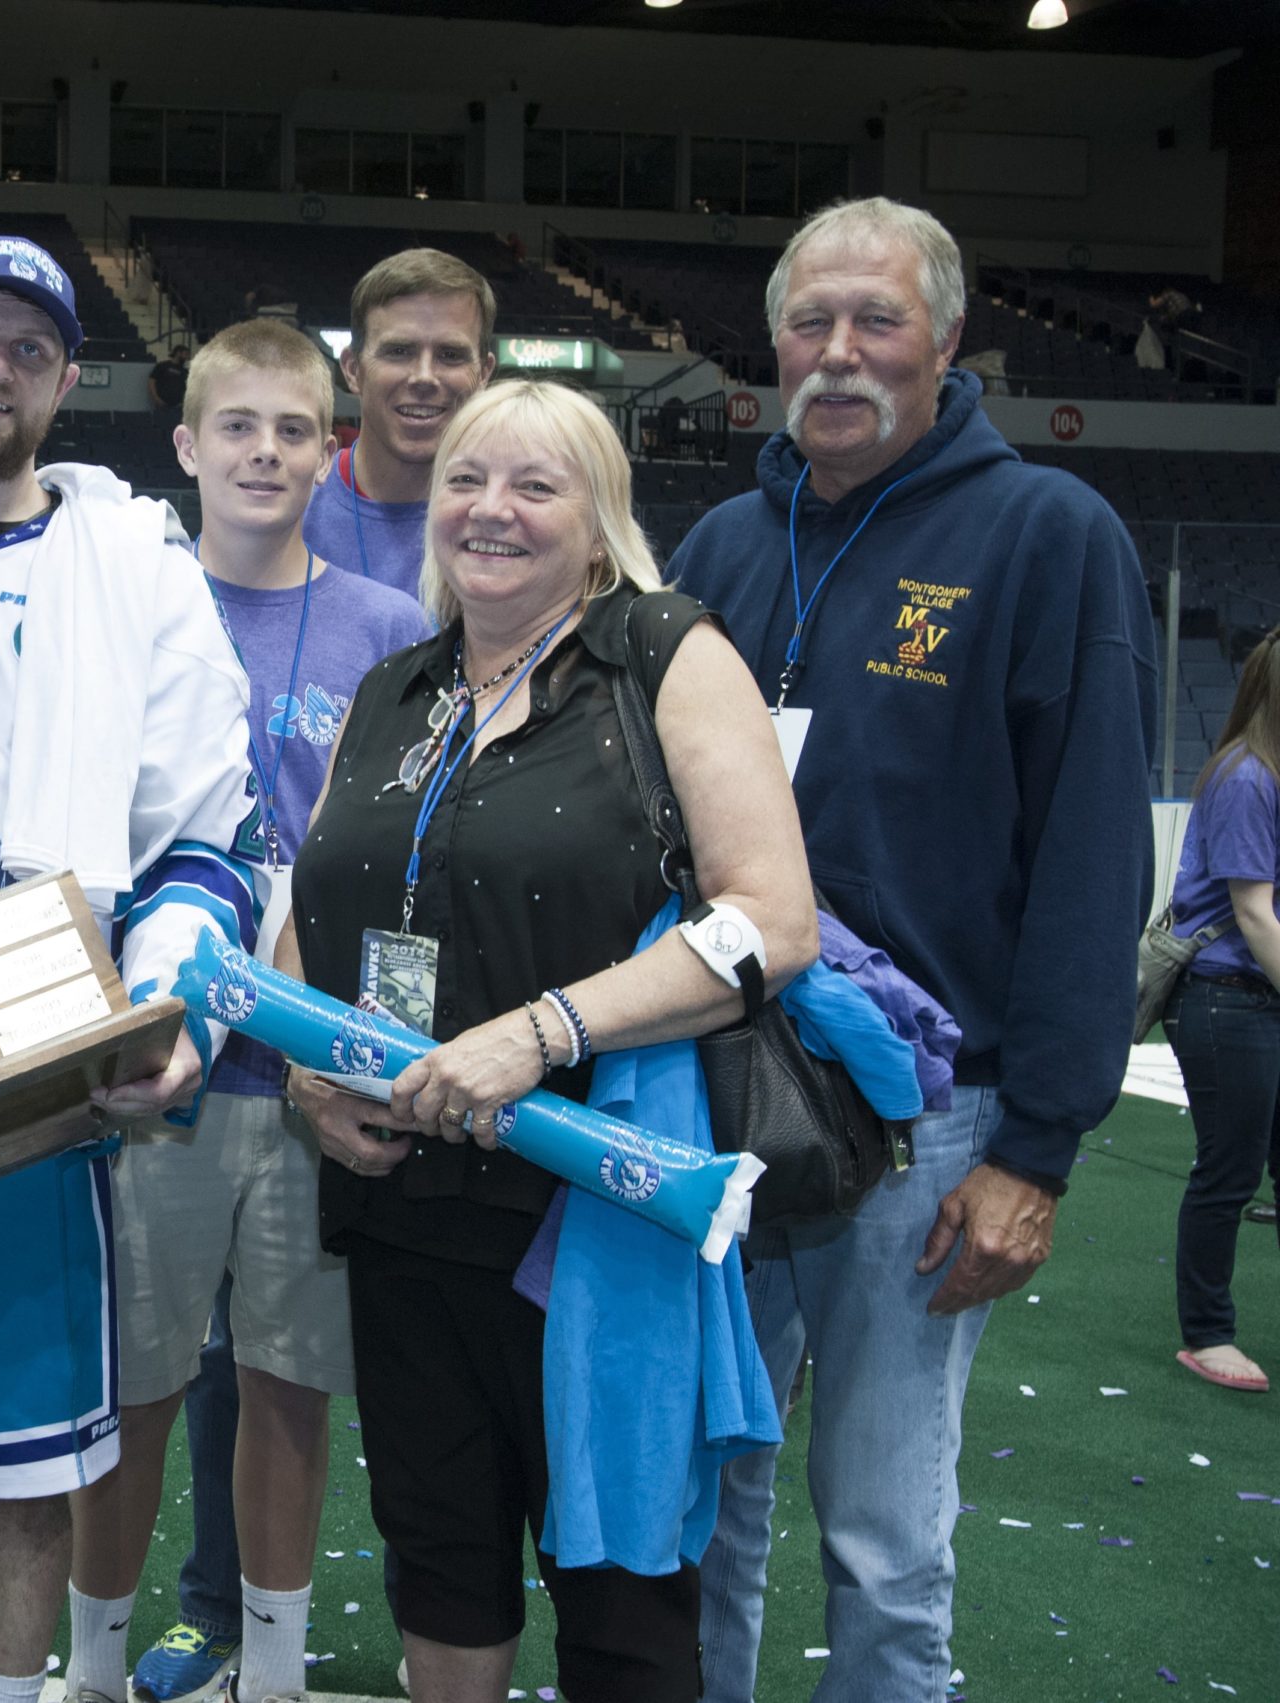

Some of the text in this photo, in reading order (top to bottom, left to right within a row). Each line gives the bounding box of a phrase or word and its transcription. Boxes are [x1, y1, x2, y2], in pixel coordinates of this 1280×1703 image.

[508, 338, 560, 360] Coke
[731, 401, 756, 419] 105
[1054, 414, 1079, 432] 104
[897, 578, 972, 599] MONTGOMERY
[910, 594, 955, 609] VILLAGE
[866, 660, 949, 686] PUBLIC SCHOOL
[390, 943, 426, 958] 2014
[206, 982, 256, 1023] KNIGHTHAWKS
[600, 1157, 660, 1201] KNIGHTHAWKS
